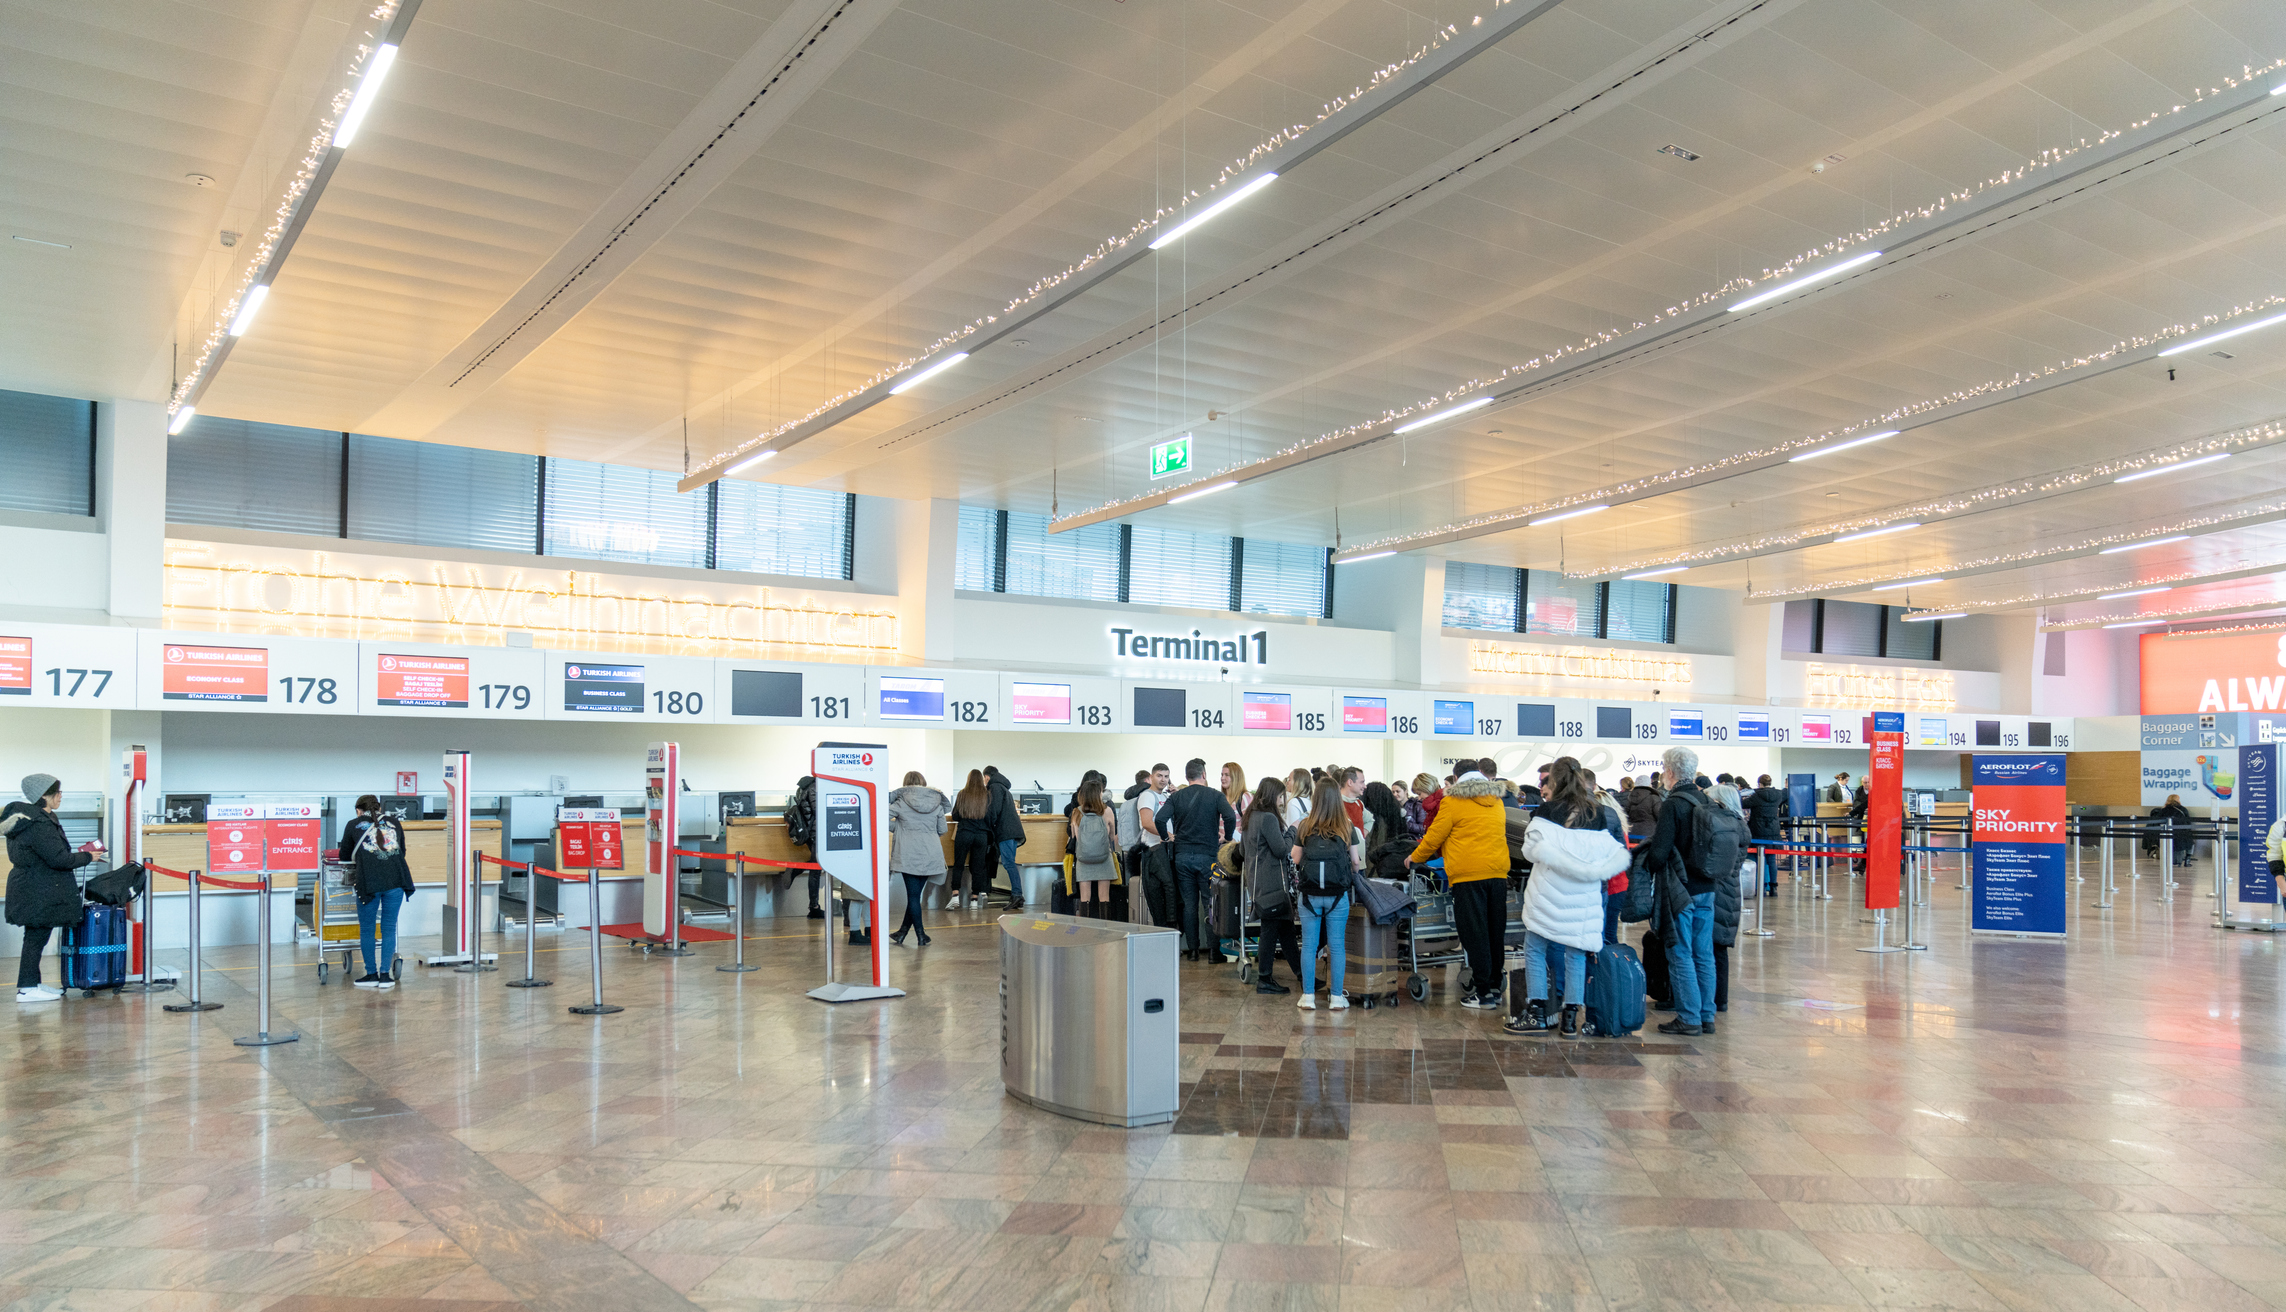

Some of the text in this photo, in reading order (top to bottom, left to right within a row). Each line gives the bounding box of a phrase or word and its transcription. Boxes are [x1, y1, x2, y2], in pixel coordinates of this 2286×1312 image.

[165, 542, 414, 622] Frohe
[1111, 628, 1267, 665] Terminal 1
[186, 651, 263, 662] TURKISH AIRLINES
[1471, 640, 1692, 688] Merry Christmas
[398, 661, 465, 670] TURKISH AIRLINES
[582, 669, 641, 678] TURKISH AIRLINES
[45, 668, 113, 698] 177
[186, 675, 244, 684] ECONOMY CLASS
[1807, 662, 1955, 702] Frohes Fest
[279, 676, 338, 704] 178
[478, 684, 531, 710] 179
[2198, 675, 2286, 712] ALW
[653, 690, 703, 715] 180
[810, 696, 849, 719] 181
[950, 701, 988, 723] 182
[1077, 705, 1112, 726] 183
[1191, 709, 1224, 728] 184
[1296, 712, 1325, 731] 185
[1391, 716, 1418, 734] 186
[1478, 719, 1502, 735] 187
[1559, 721, 1583, 737] 188
[2142, 723, 2194, 734] Baggage
[1635, 723, 1657, 739] 189
[1706, 726, 1727, 741] 190
[1772, 728, 1789, 742] 191
[1834, 730, 1851, 744] 192
[1949, 732, 1966, 745] 194
[2003, 734, 2019, 746] 195
[2053, 735, 2069, 748] 196
[2142, 736, 2183, 745] Corner
[2143, 767, 2191, 778] Baggage
[2143, 778, 2198, 791] Wrapping
[1975, 809, 2011, 820] SKY
[1975, 821, 2058, 833] PRIORITY
[272, 846, 313, 854] ENTRANCE
